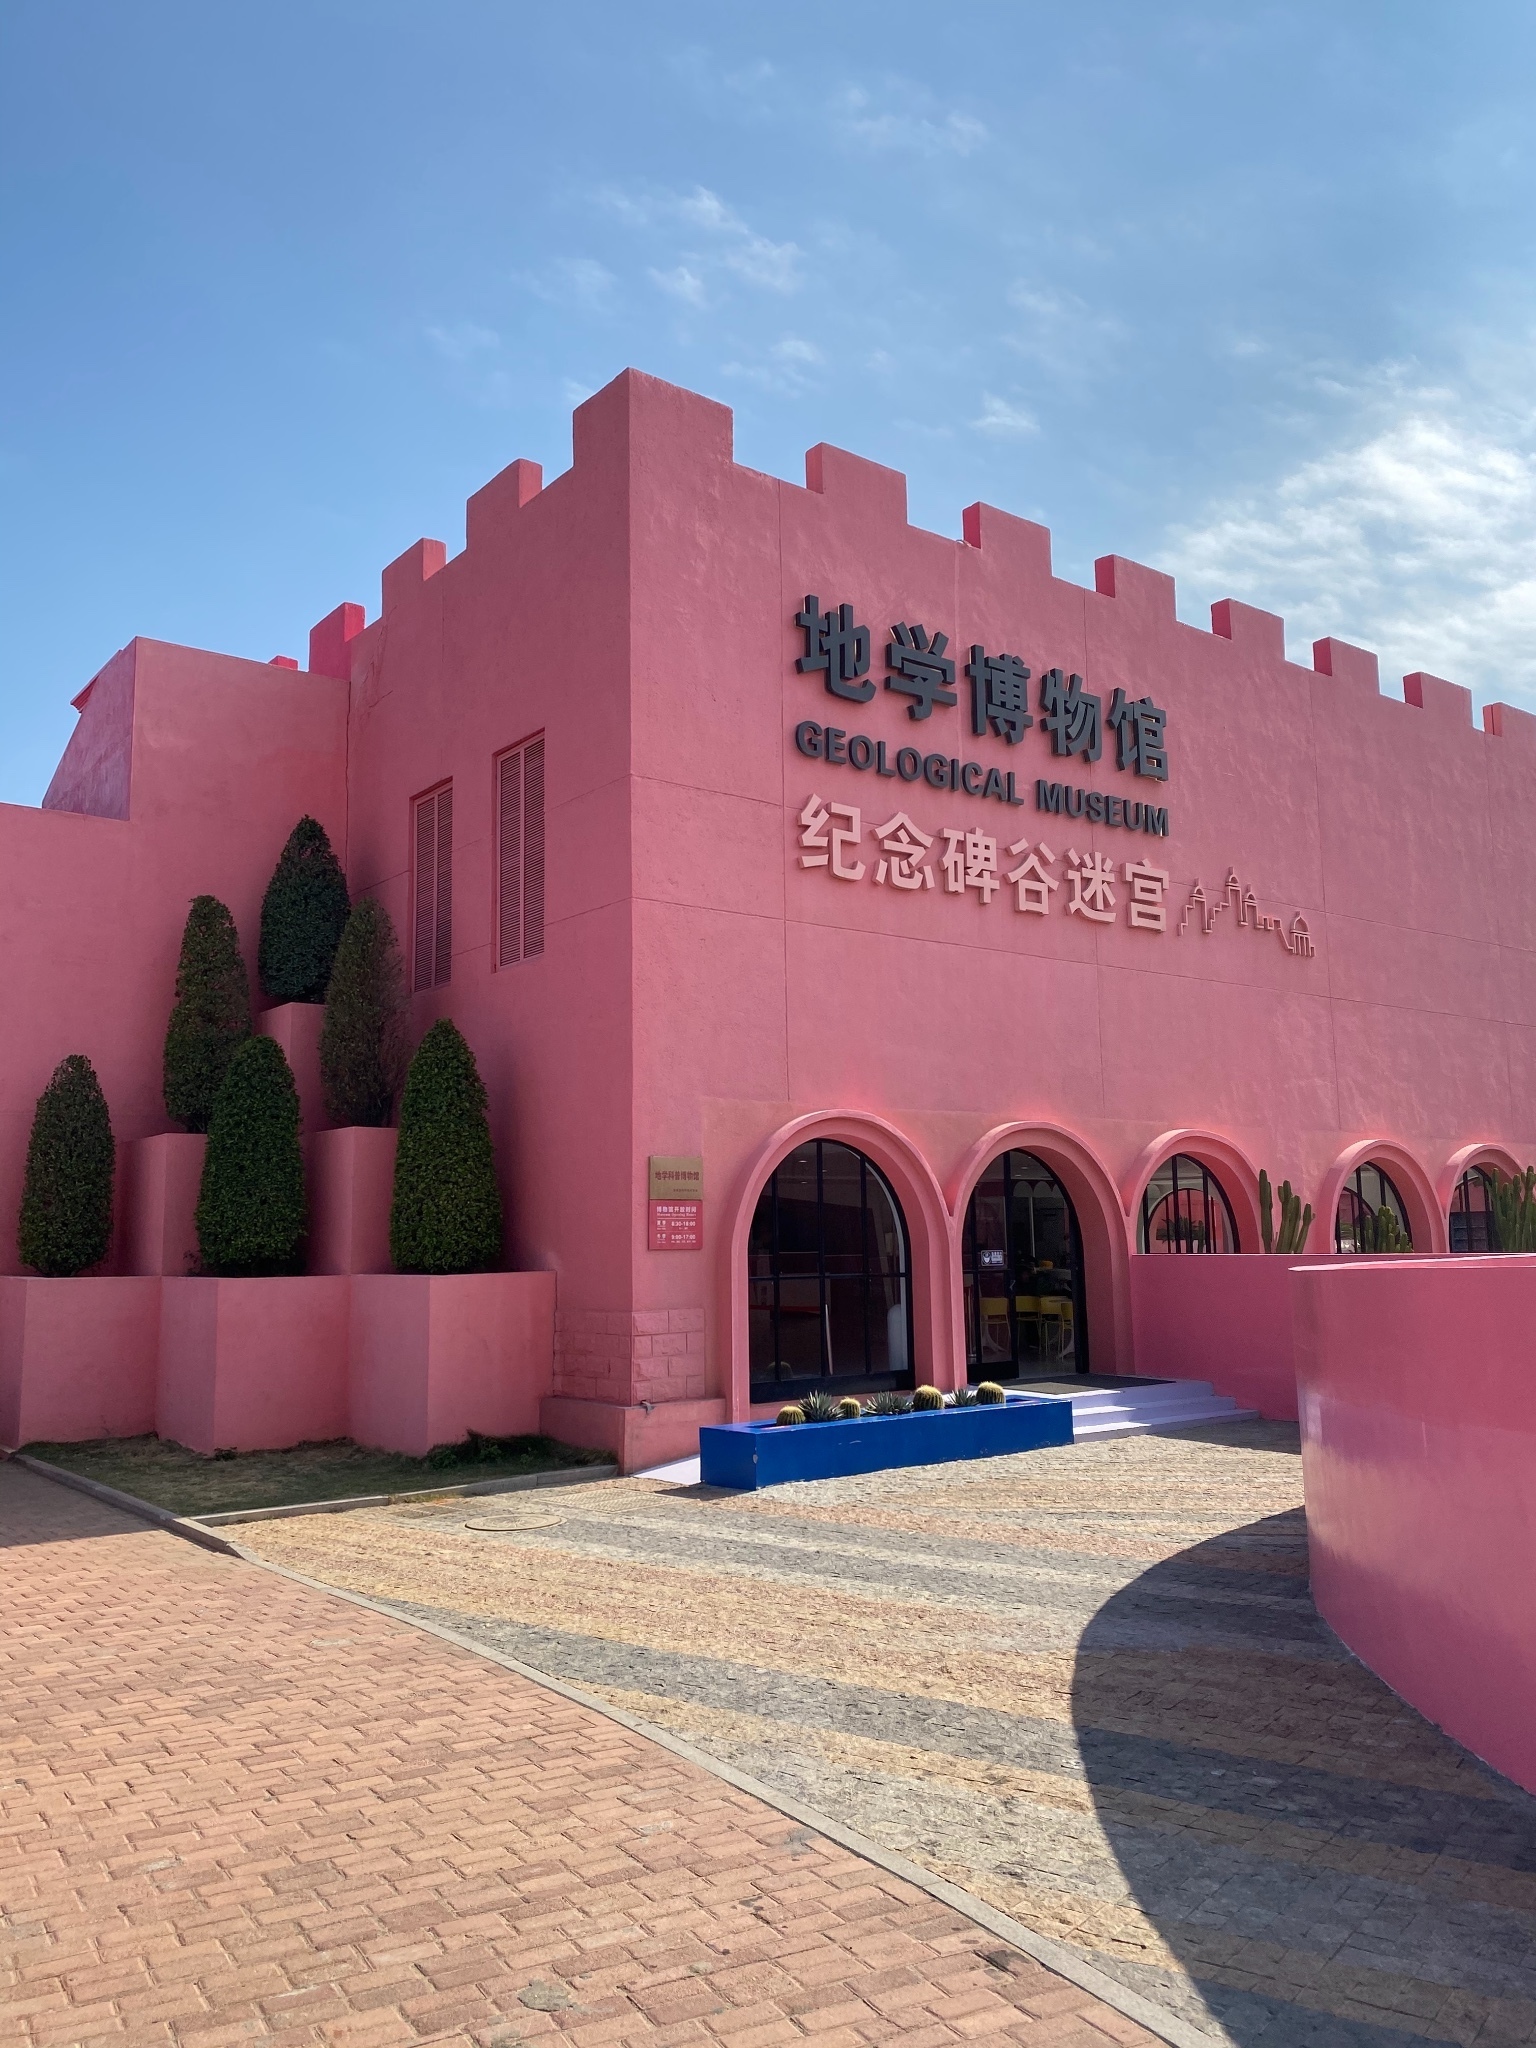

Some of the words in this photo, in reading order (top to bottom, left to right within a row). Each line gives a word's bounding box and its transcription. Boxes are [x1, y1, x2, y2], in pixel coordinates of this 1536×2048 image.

[795, 594, 1169, 782] 地学博物馆
[795, 720, 1024, 806] GEOLOGICAL
[1035, 778, 1170, 838] MUSEUM
[798, 793, 1170, 934] 纪念碑谷迷宫
